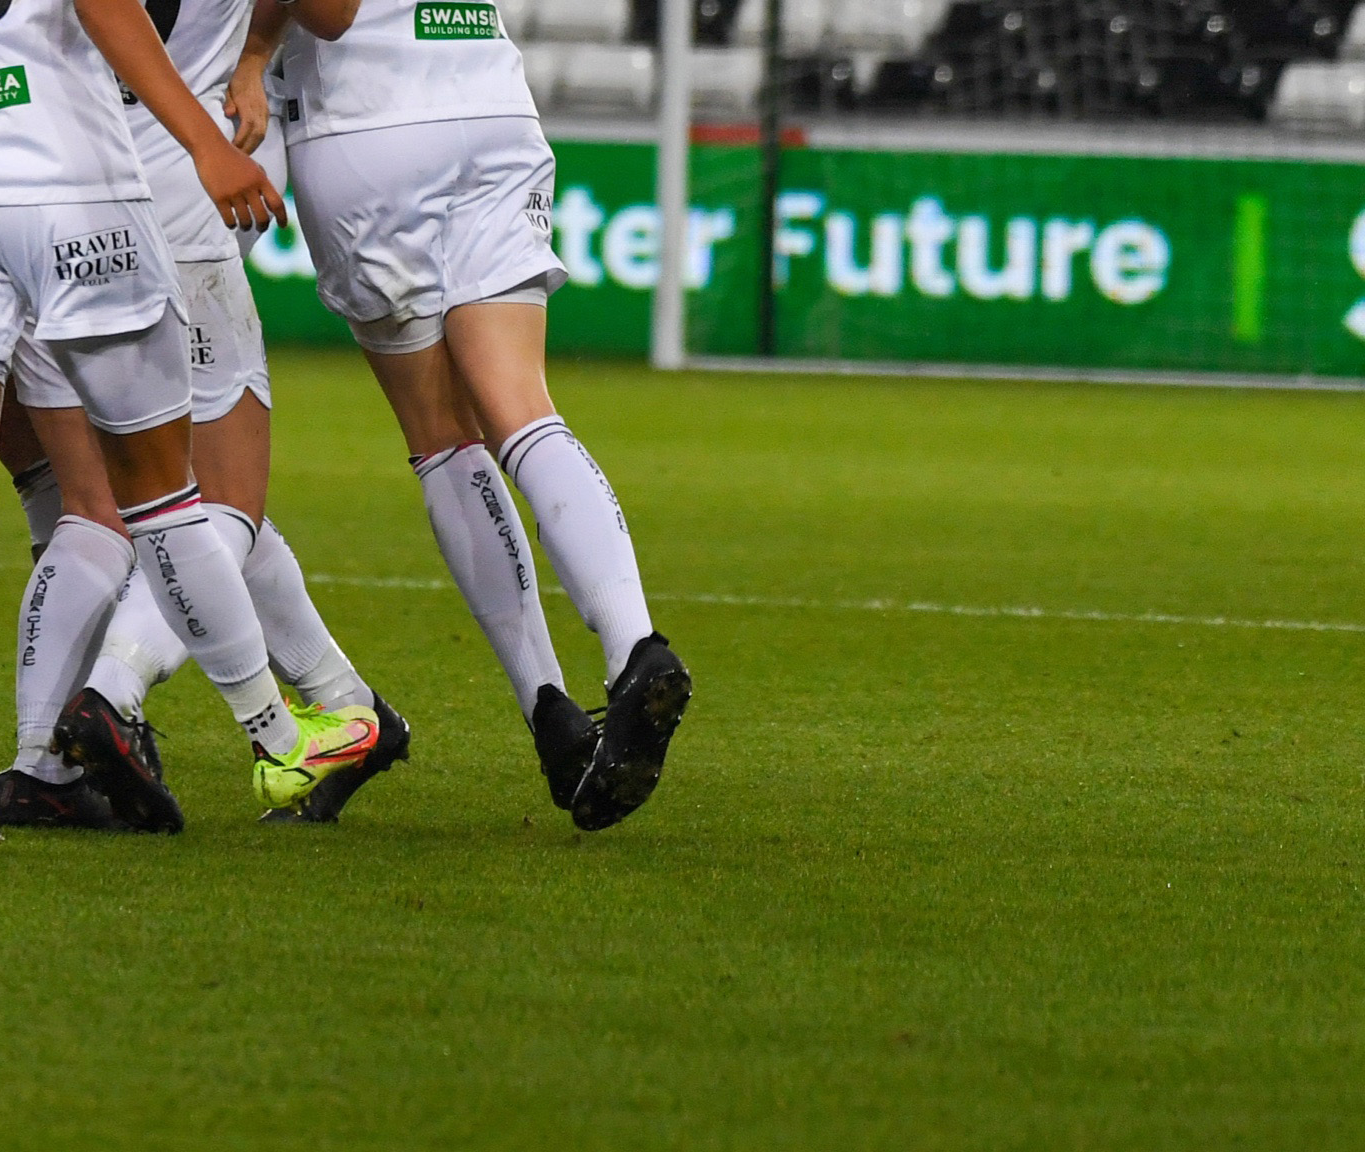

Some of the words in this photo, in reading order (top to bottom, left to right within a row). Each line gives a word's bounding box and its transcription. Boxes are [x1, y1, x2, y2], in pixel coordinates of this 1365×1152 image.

[424, 25, 471, 35] BUILDING
[52, 229, 137, 262] TRAVEL
[771, 190, 1171, 307] Future
[54, 250, 140, 280] HOUSE
[471, 470, 505, 526] SWANSEA
[497, 524, 520, 560] CITY
[515, 562, 530, 591] AFC
[168, 586, 194, 615] CITY
[25, 615, 42, 644] CITY
